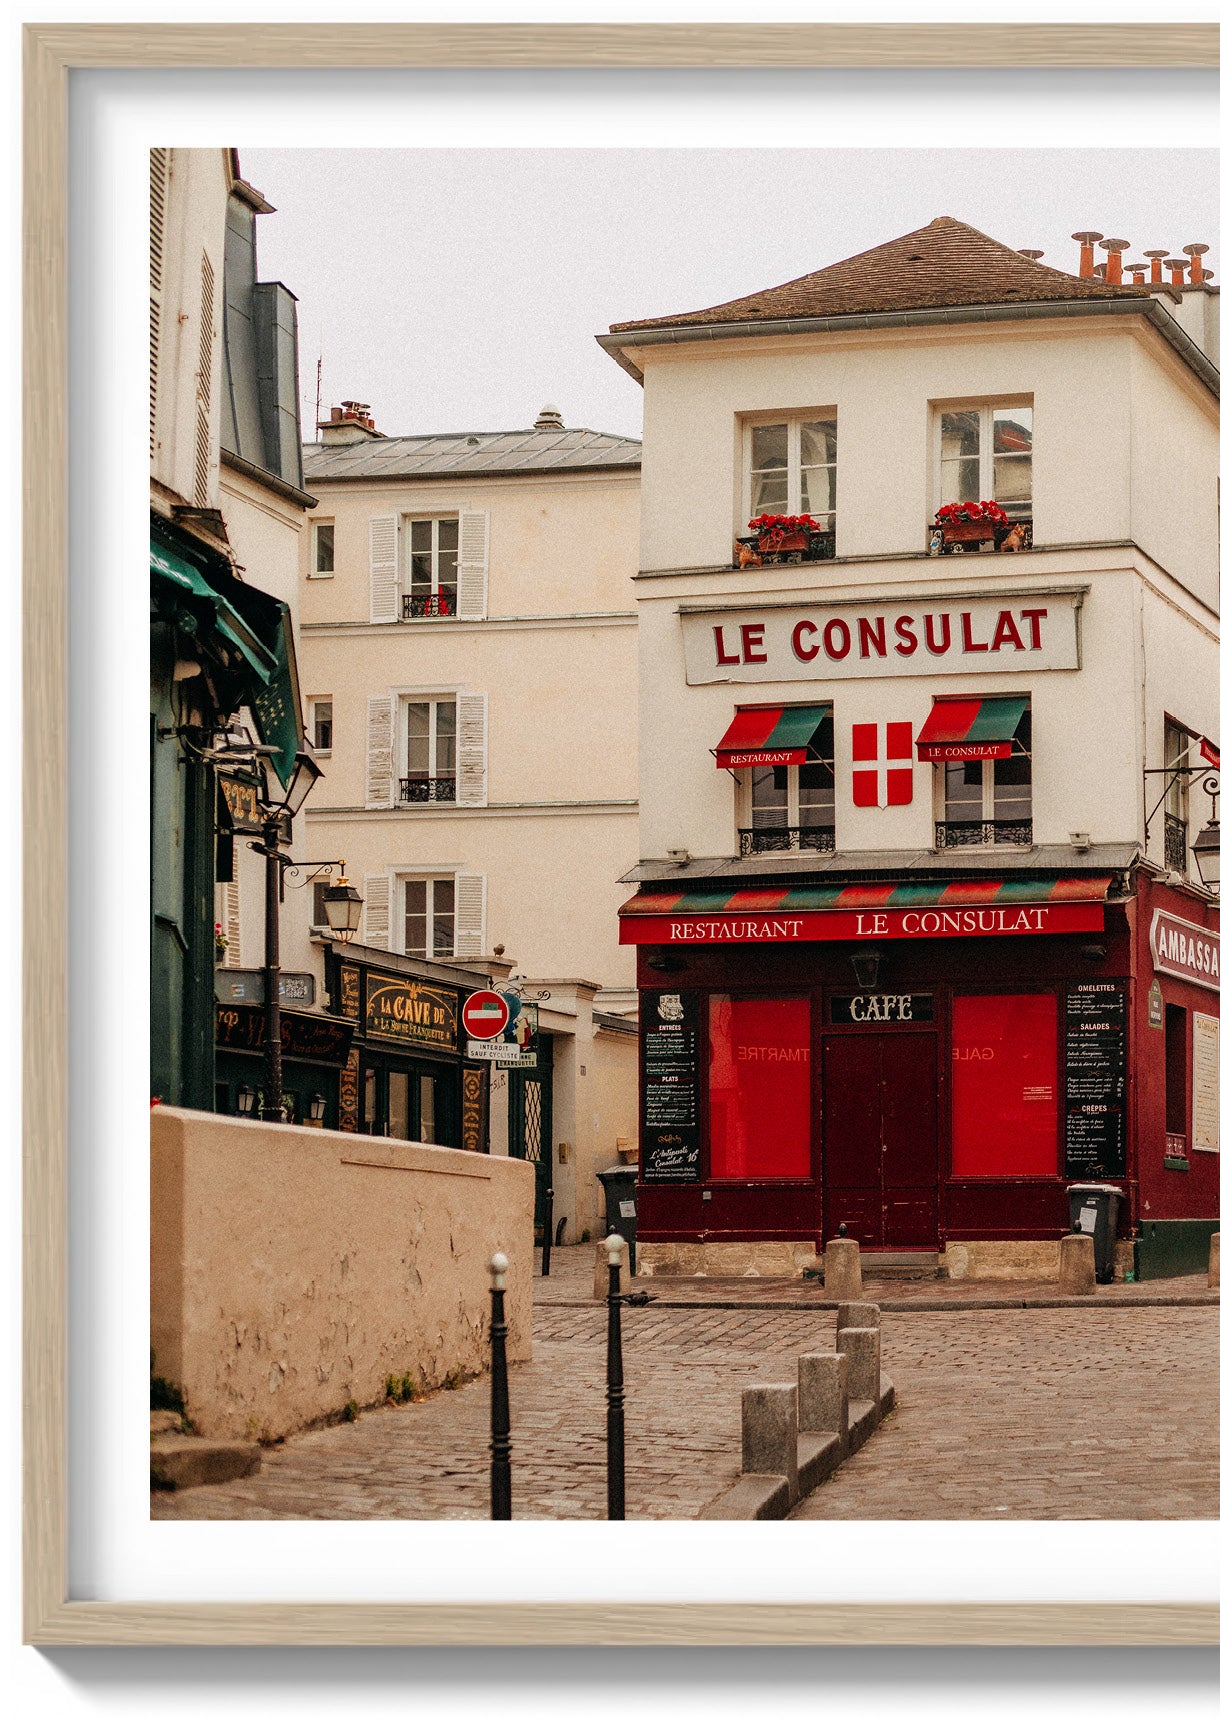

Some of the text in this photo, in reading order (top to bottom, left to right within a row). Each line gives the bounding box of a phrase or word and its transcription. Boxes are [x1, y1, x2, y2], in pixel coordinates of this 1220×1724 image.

[712, 609, 1048, 666] LE CONSULAT
[729, 752, 793, 765] RESTAURANT
[928, 745, 1000, 757] LE CONSULAT
[669, 908, 1049, 940] RESTAURANT LE CONSULAT
[1078, 984, 1115, 992] OMELETTES
[380, 996, 445, 1025] LA CAVE DE
